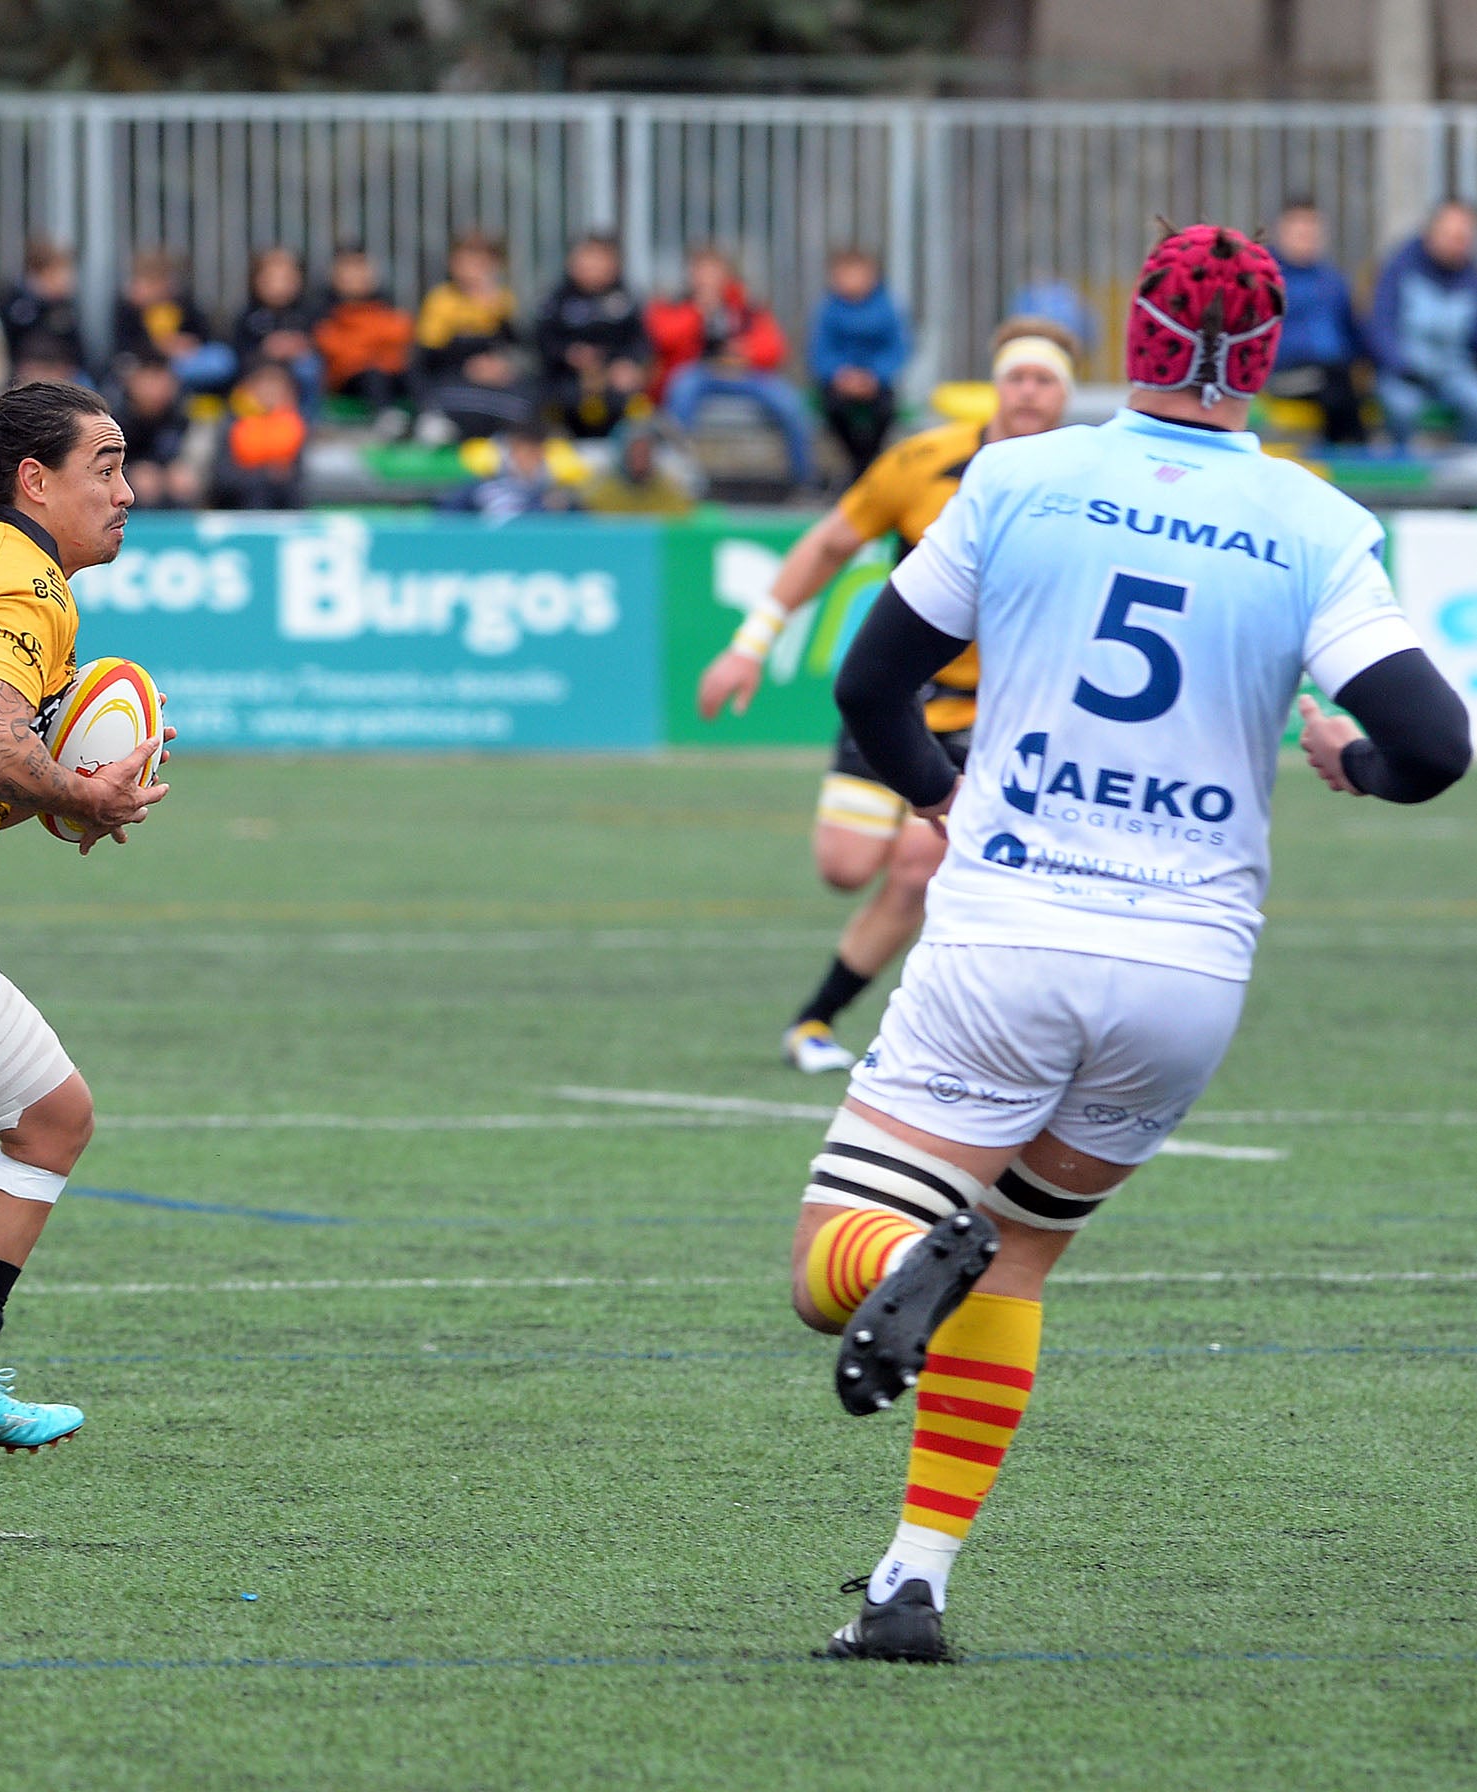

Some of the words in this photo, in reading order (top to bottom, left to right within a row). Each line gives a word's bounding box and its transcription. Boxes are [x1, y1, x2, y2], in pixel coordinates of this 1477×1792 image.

[1087, 500, 1290, 570] SUMAL
[279, 534, 617, 655] Burgos
[1073, 573, 1188, 723] 5
[1002, 733, 1235, 823] NAEKO
[1042, 803, 1227, 847] LOGISTICS
